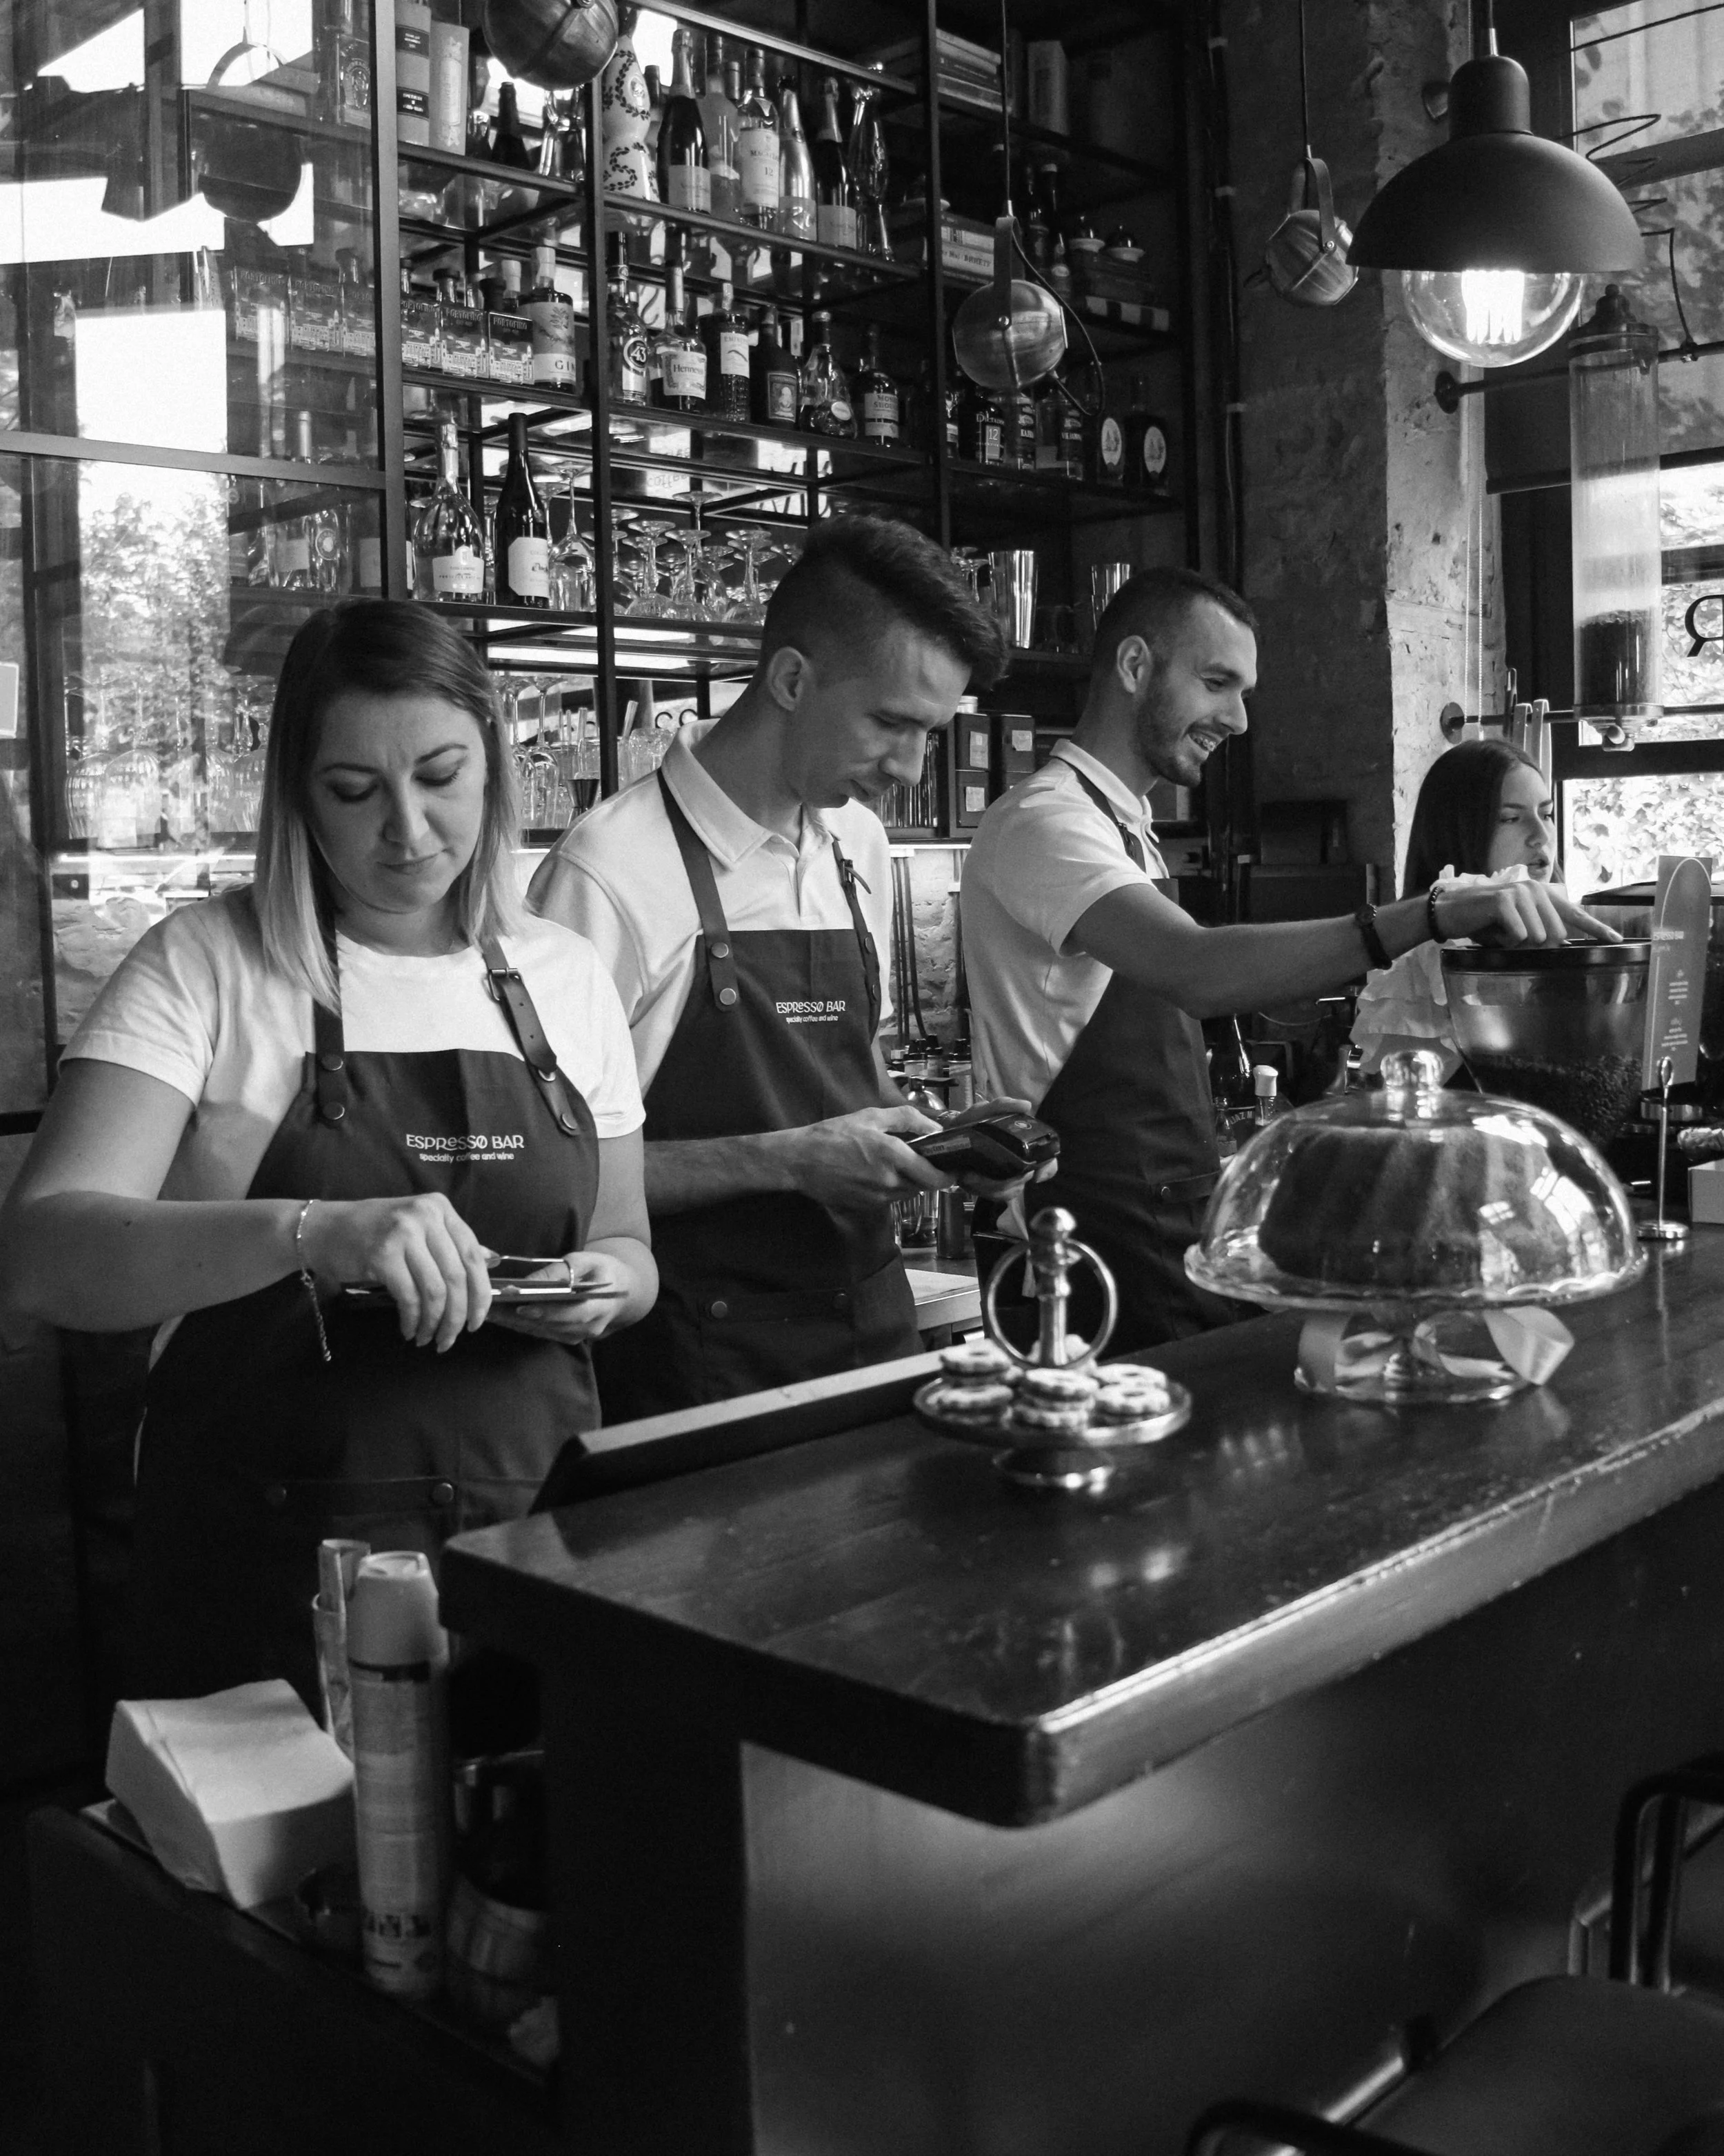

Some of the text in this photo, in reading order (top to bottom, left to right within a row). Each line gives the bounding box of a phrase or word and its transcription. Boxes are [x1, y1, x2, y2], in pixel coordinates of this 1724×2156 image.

[765, 167, 774, 177] 12
[630, 346, 646, 363] 43
[989, 428, 999, 441] 12
[826, 1001, 845, 1012] BAR
[492, 1135, 524, 1149] BAR
[419, 1152, 514, 1164] specialty coffee and wine
